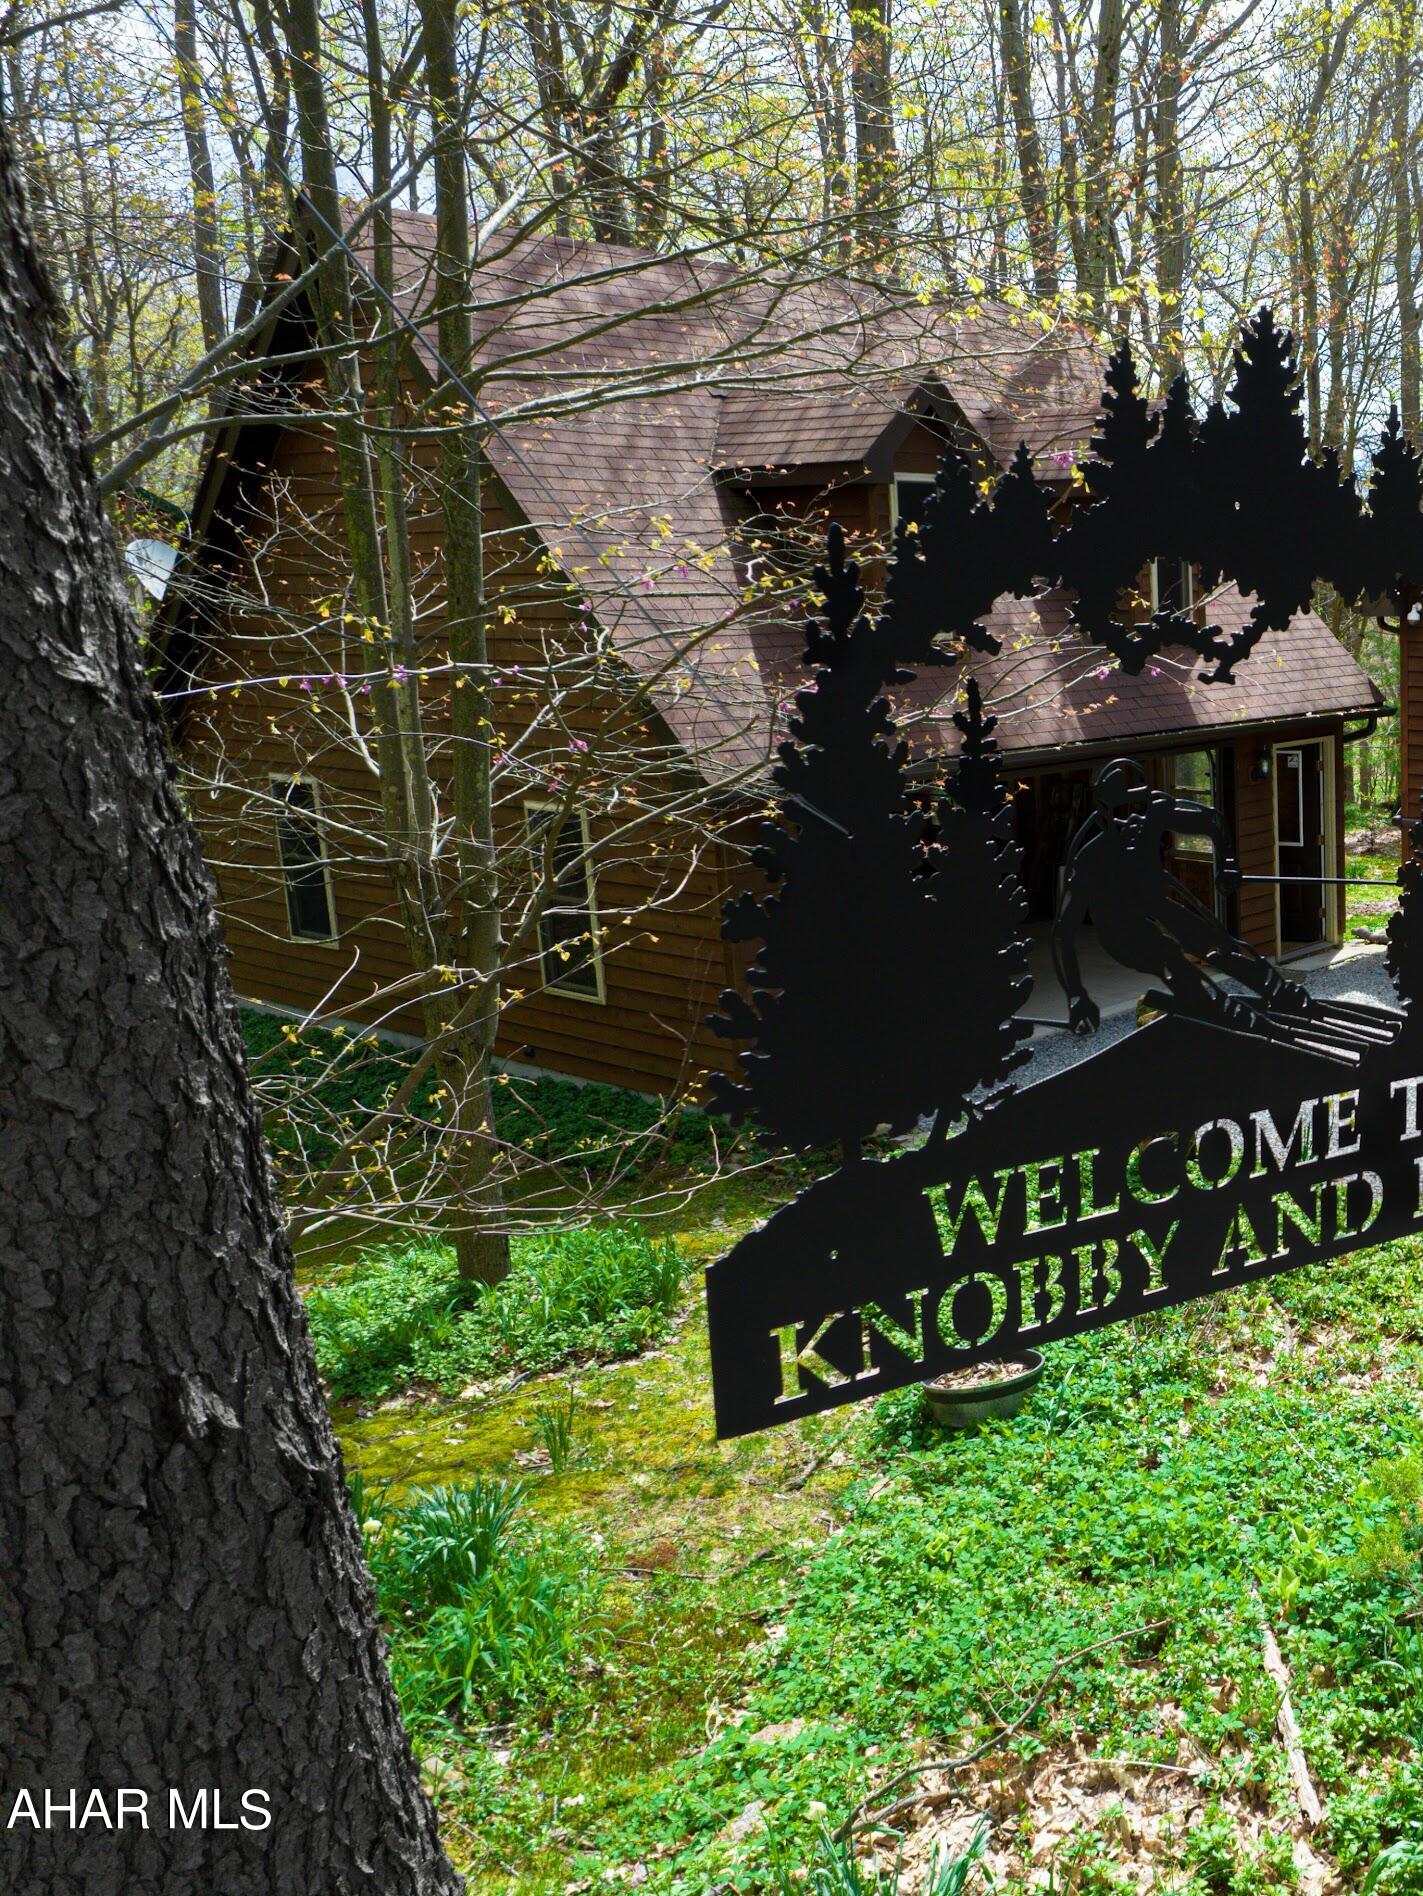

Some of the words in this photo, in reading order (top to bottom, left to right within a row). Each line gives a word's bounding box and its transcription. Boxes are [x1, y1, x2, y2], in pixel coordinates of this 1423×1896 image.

[922, 1088, 1362, 1257] WELCOME
[768, 1219, 1182, 1405] KNOBBY
[1211, 1169, 1383, 1276] AND
